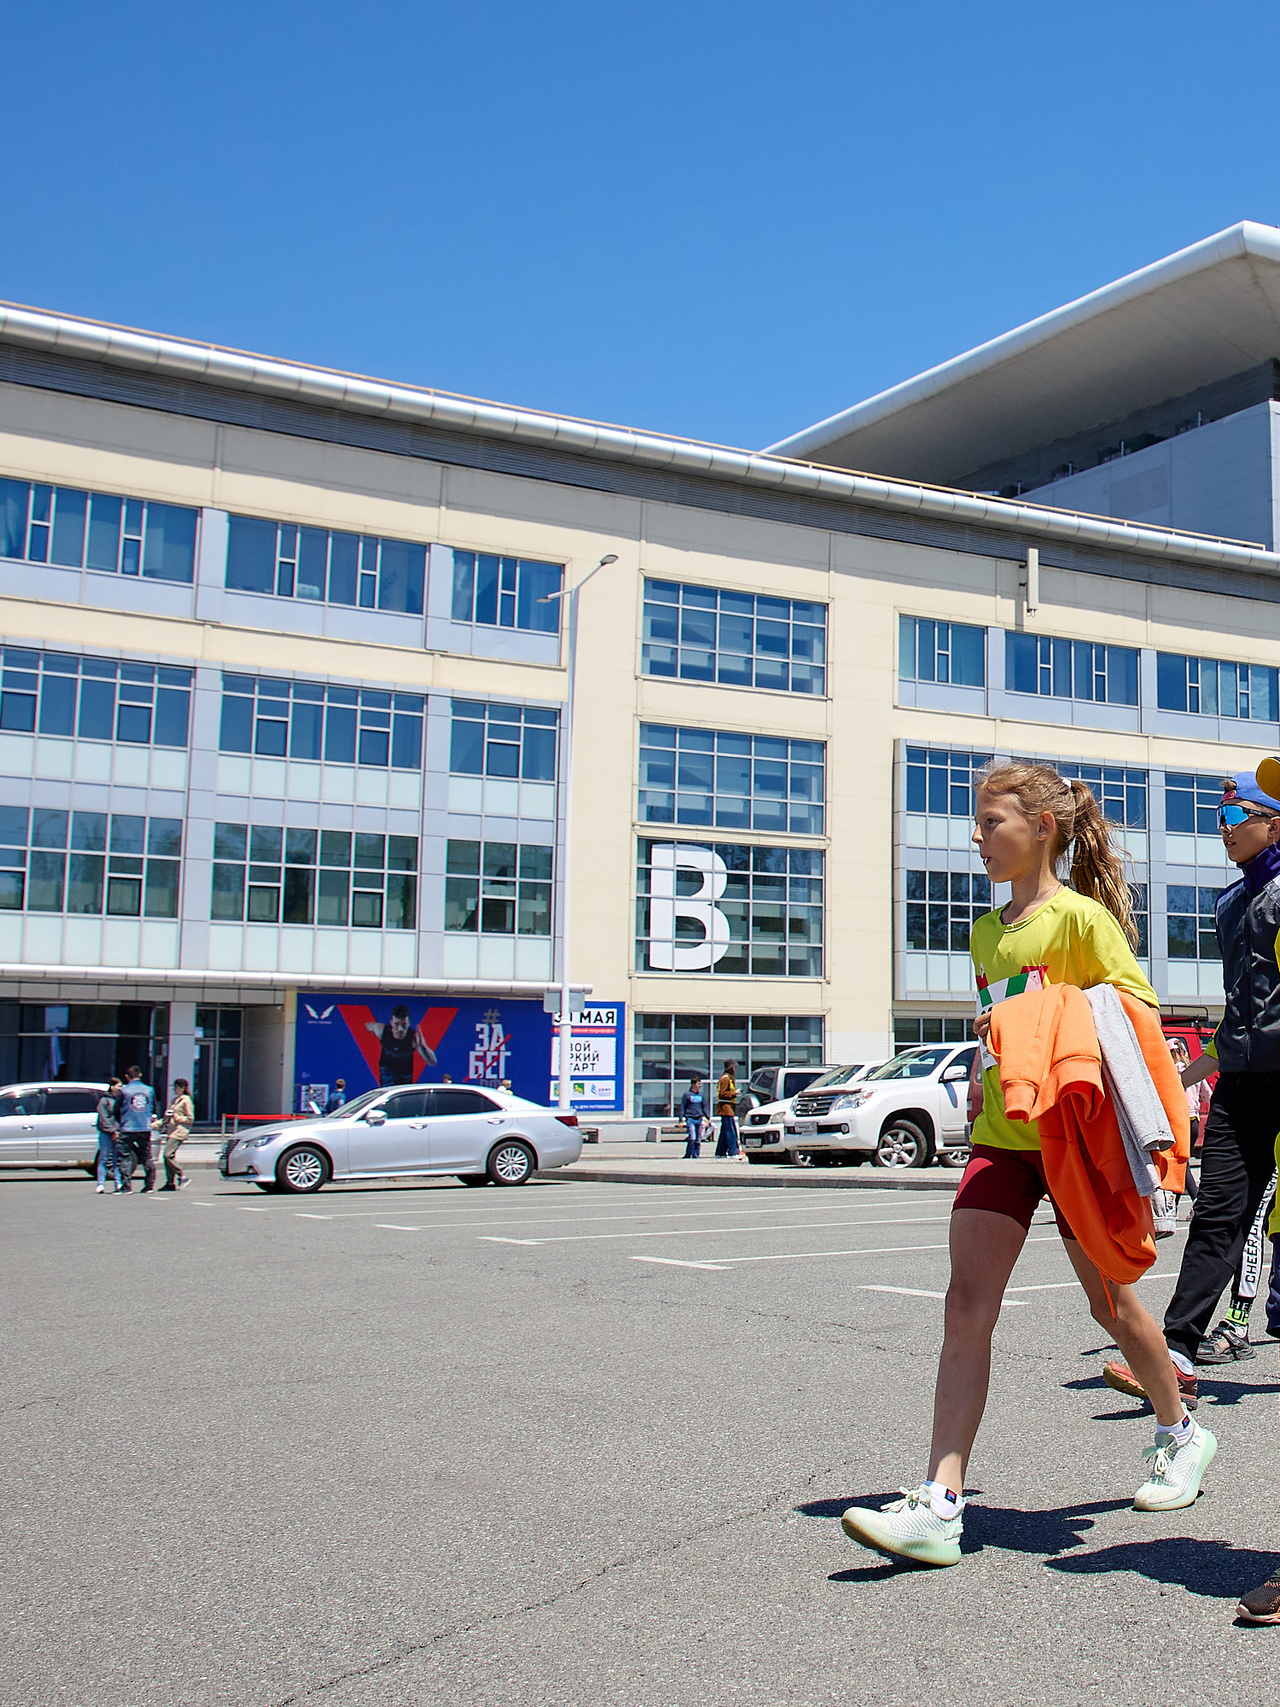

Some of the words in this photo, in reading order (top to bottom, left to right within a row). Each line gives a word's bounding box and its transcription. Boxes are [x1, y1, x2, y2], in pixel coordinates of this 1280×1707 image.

[649, 843, 731, 971] B
[580, 1011, 615, 1024] МАЯ
[474, 1023, 507, 1051] ЗА
[570, 1041, 591, 1052] ОЙ
[468, 1051, 512, 1079] БЕГ
[570, 1051, 600, 1062] КИЙ
[570, 1063, 597, 1072] АРТ
[1245, 1239, 1258, 1284] CHEER
